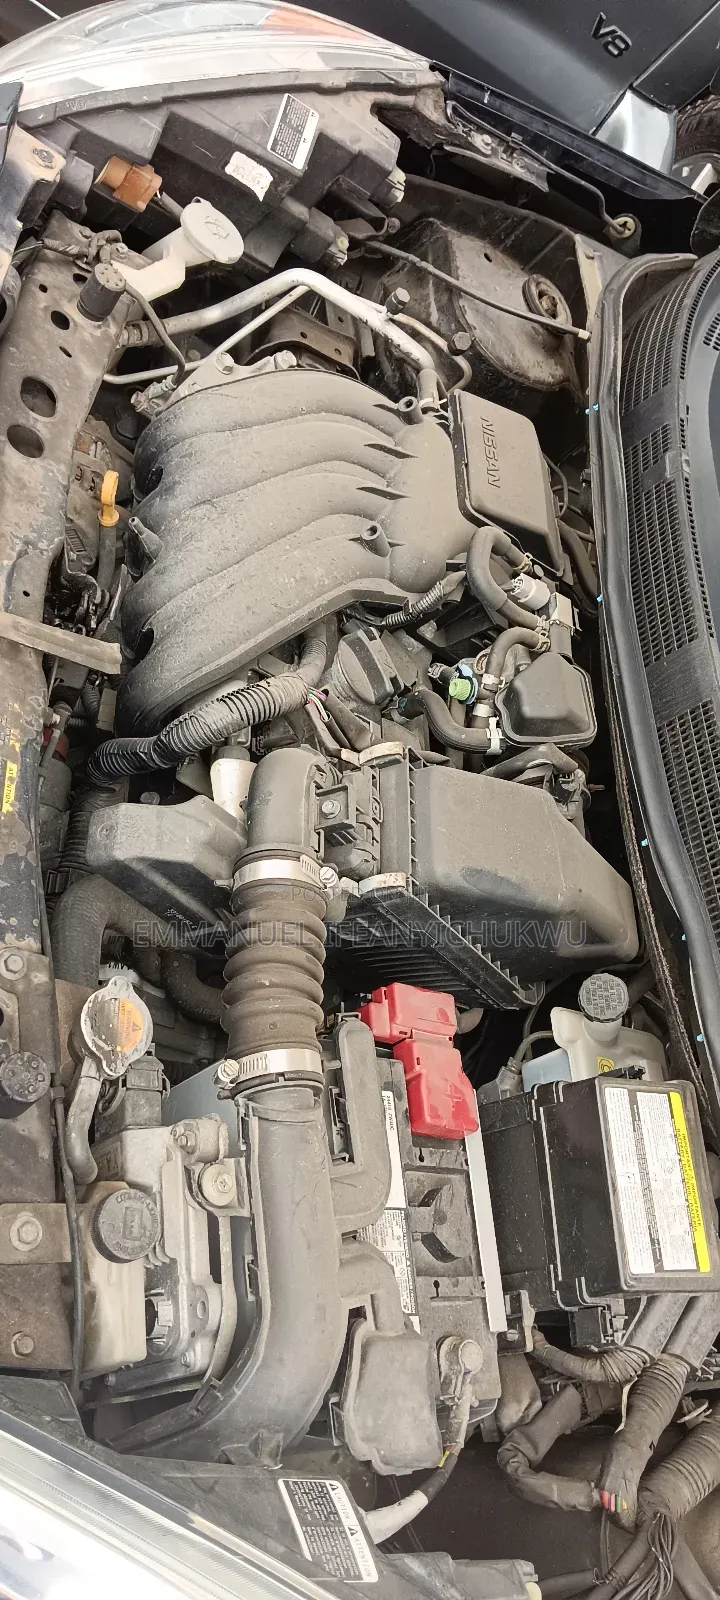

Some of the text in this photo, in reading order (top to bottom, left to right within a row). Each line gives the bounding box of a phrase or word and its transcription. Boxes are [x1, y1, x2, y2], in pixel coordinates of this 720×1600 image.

[591, 11, 632, 58] V8
[480, 416, 501, 489] NISSAN
[5, 766, 14, 804] ATNTION
[682, 1133, 701, 1227] IMPORTANT IMPORTANTE
[335, 1492, 351, 1520] CAUTION
[353, 1537, 372, 1577] ATTENTION
